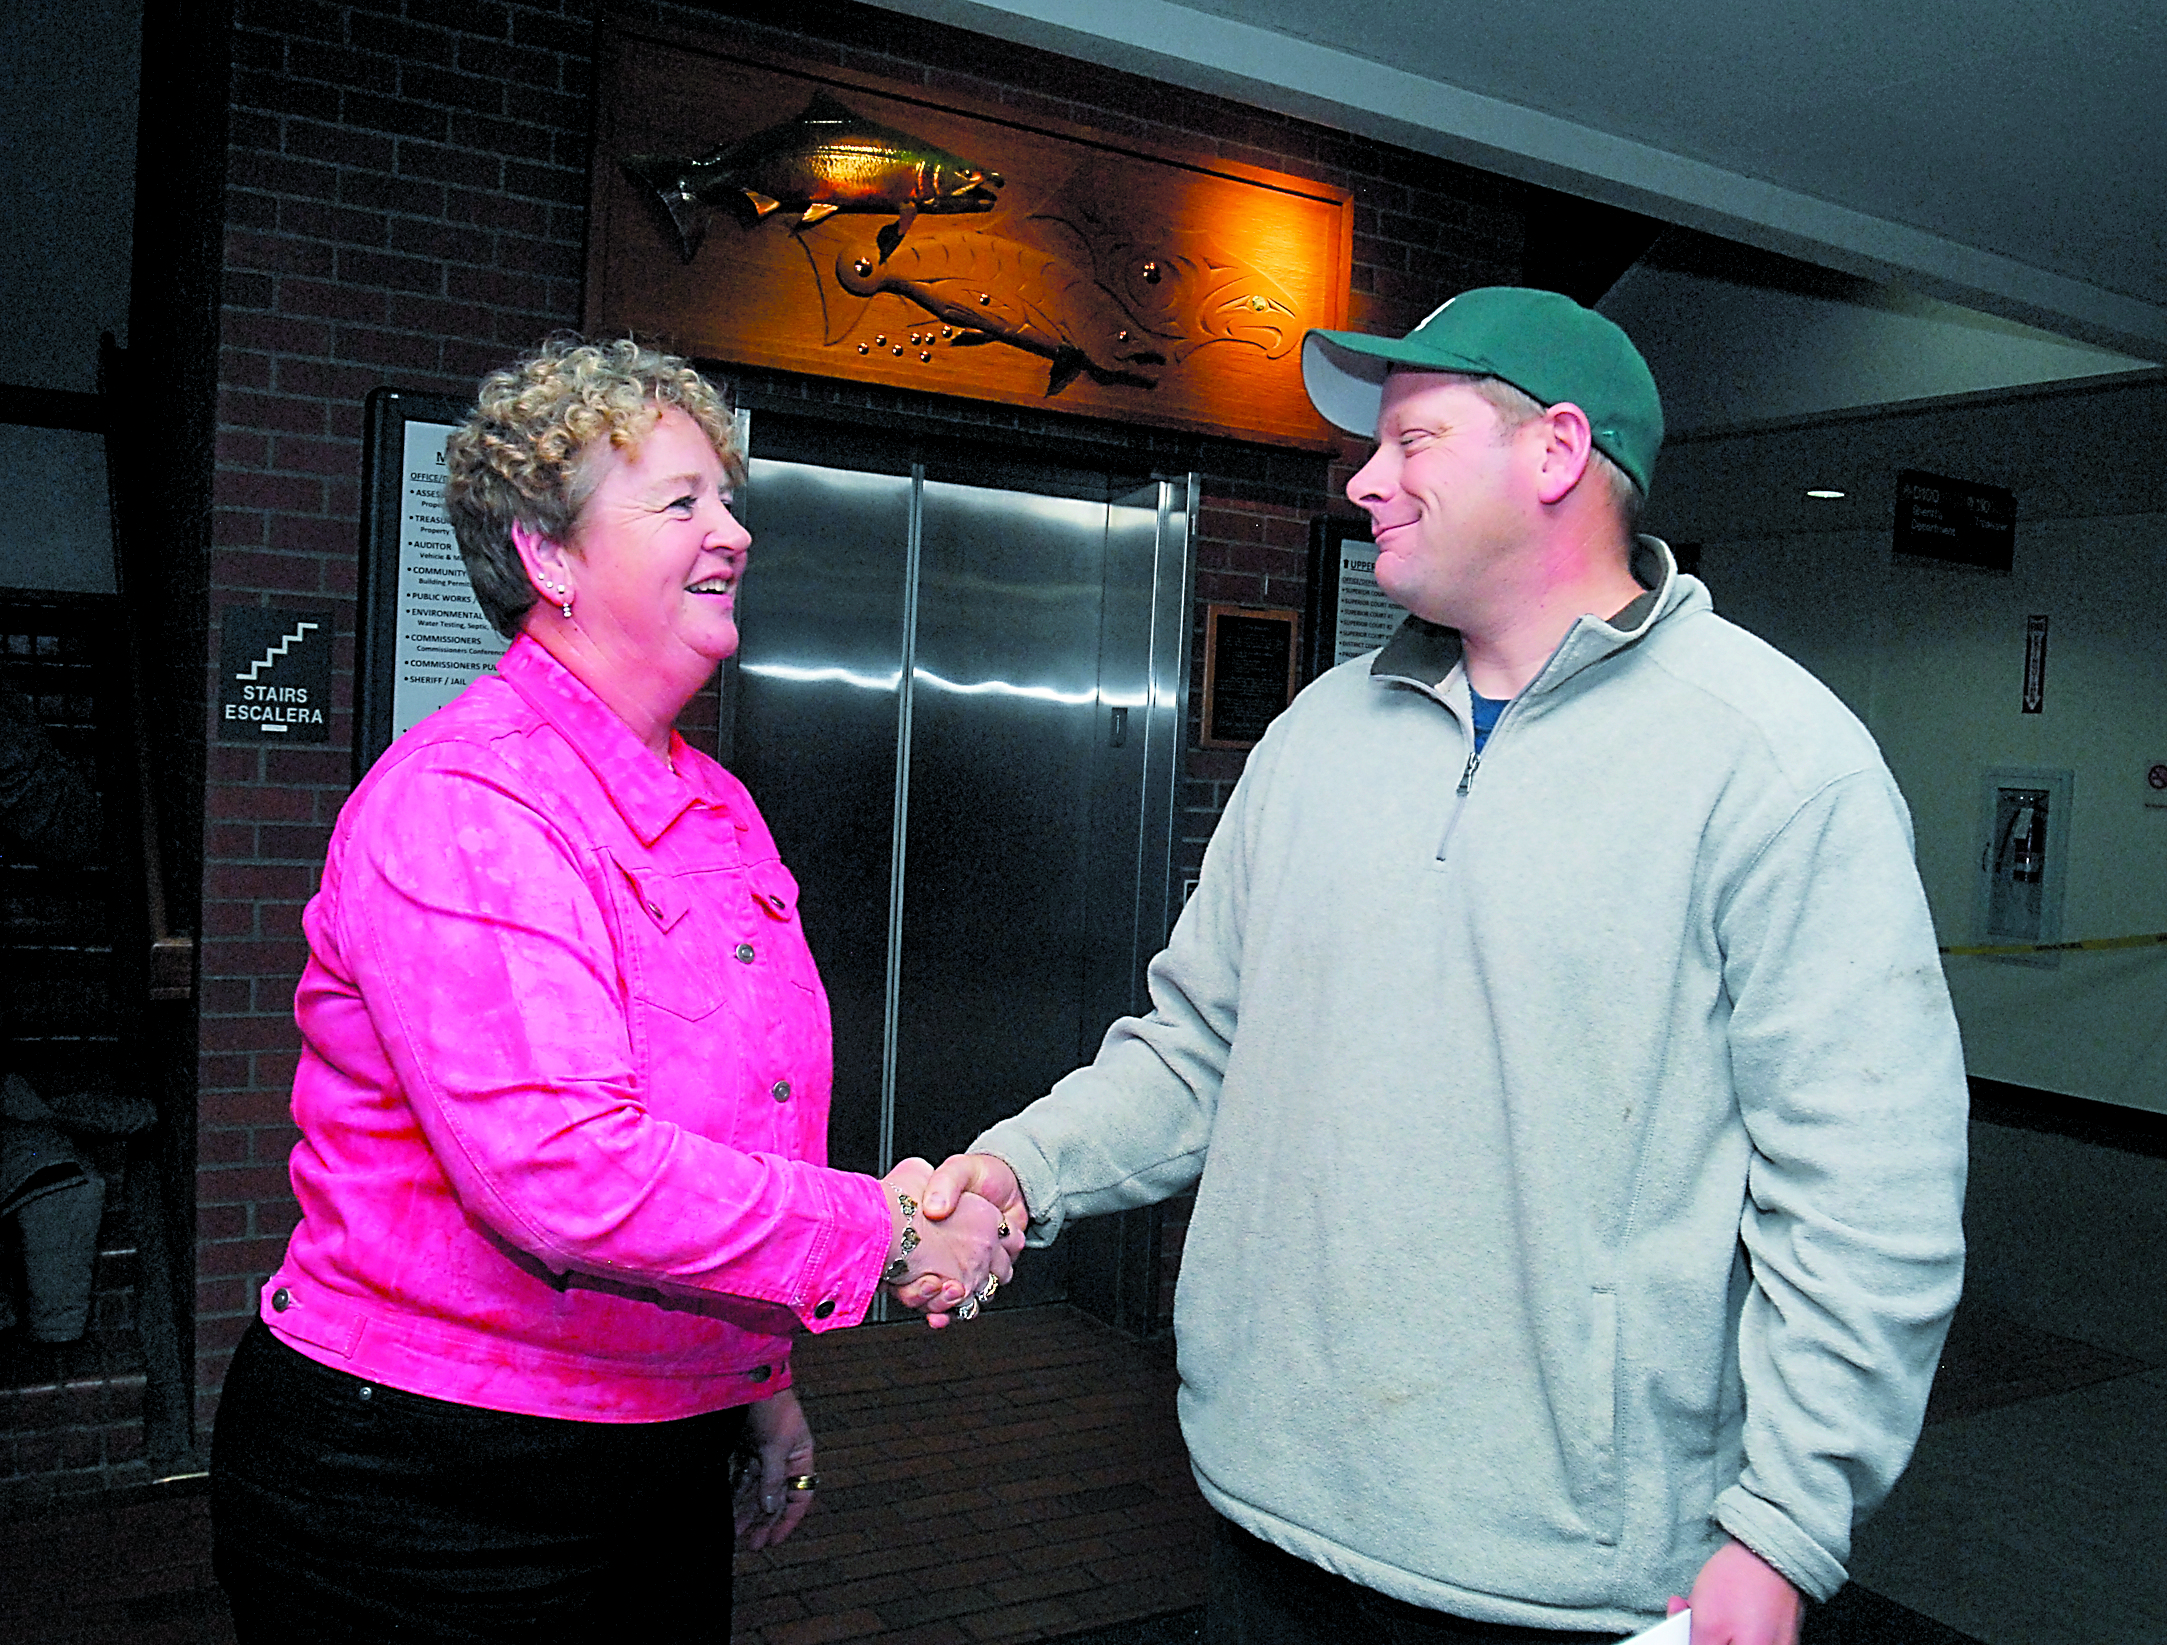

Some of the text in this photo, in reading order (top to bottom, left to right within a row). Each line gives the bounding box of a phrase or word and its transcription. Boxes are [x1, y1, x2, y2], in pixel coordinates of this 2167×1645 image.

[420, 527, 450, 536] Property
[414, 541, 452, 550] AUDITOR
[420, 552, 444, 560] Vehicle
[413, 566, 467, 577] COMMUNITY
[419, 578, 446, 586] Building
[412, 593, 440, 601] PUBLIC
[442, 595, 471, 603] WORKS
[411, 608, 483, 620] ENVIRONMENTAL
[1344, 609, 1368, 617] SUPERIOR
[411, 634, 481, 645] COMMISSIONERS
[417, 645, 467, 654] Commissioners
[410, 660, 480, 670] COMMISSIONERS
[409, 676, 442, 684] SHERIFF
[450, 677, 466, 686] JAIL
[243, 685, 308, 703] STAIRS
[225, 704, 323, 724] ESCALERA
